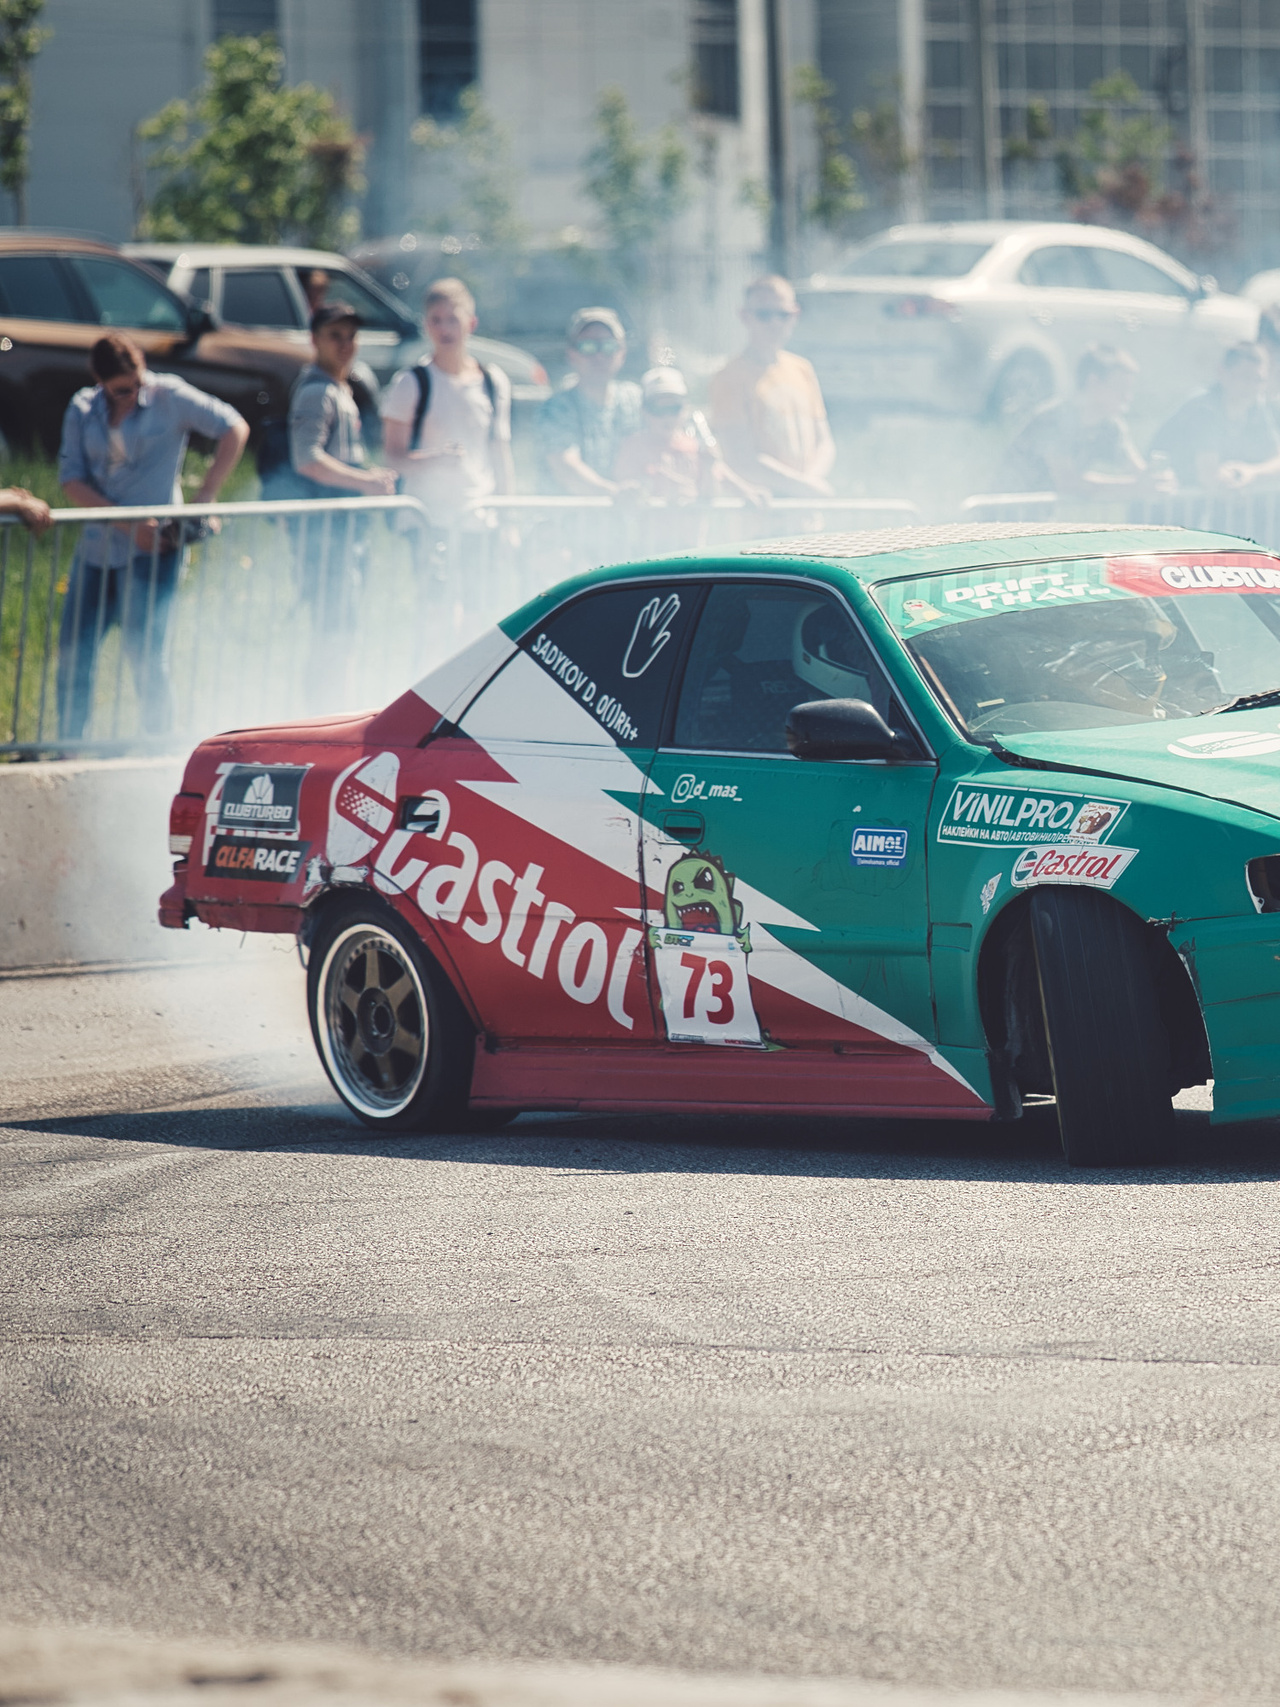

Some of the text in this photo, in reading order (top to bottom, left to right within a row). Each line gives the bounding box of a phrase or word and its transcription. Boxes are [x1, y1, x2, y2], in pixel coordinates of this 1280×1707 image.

[945, 572, 1068, 603] DRIFT
[532, 633, 589, 692] SADYKOV
[581, 681, 597, 708] D.
[223, 803, 294, 821] CLUBTURBO
[854, 834, 903, 853] AIMOL
[1032, 849, 1123, 880] Castrol
[372, 789, 649, 1031] Castrol
[680, 951, 735, 1025] 73
